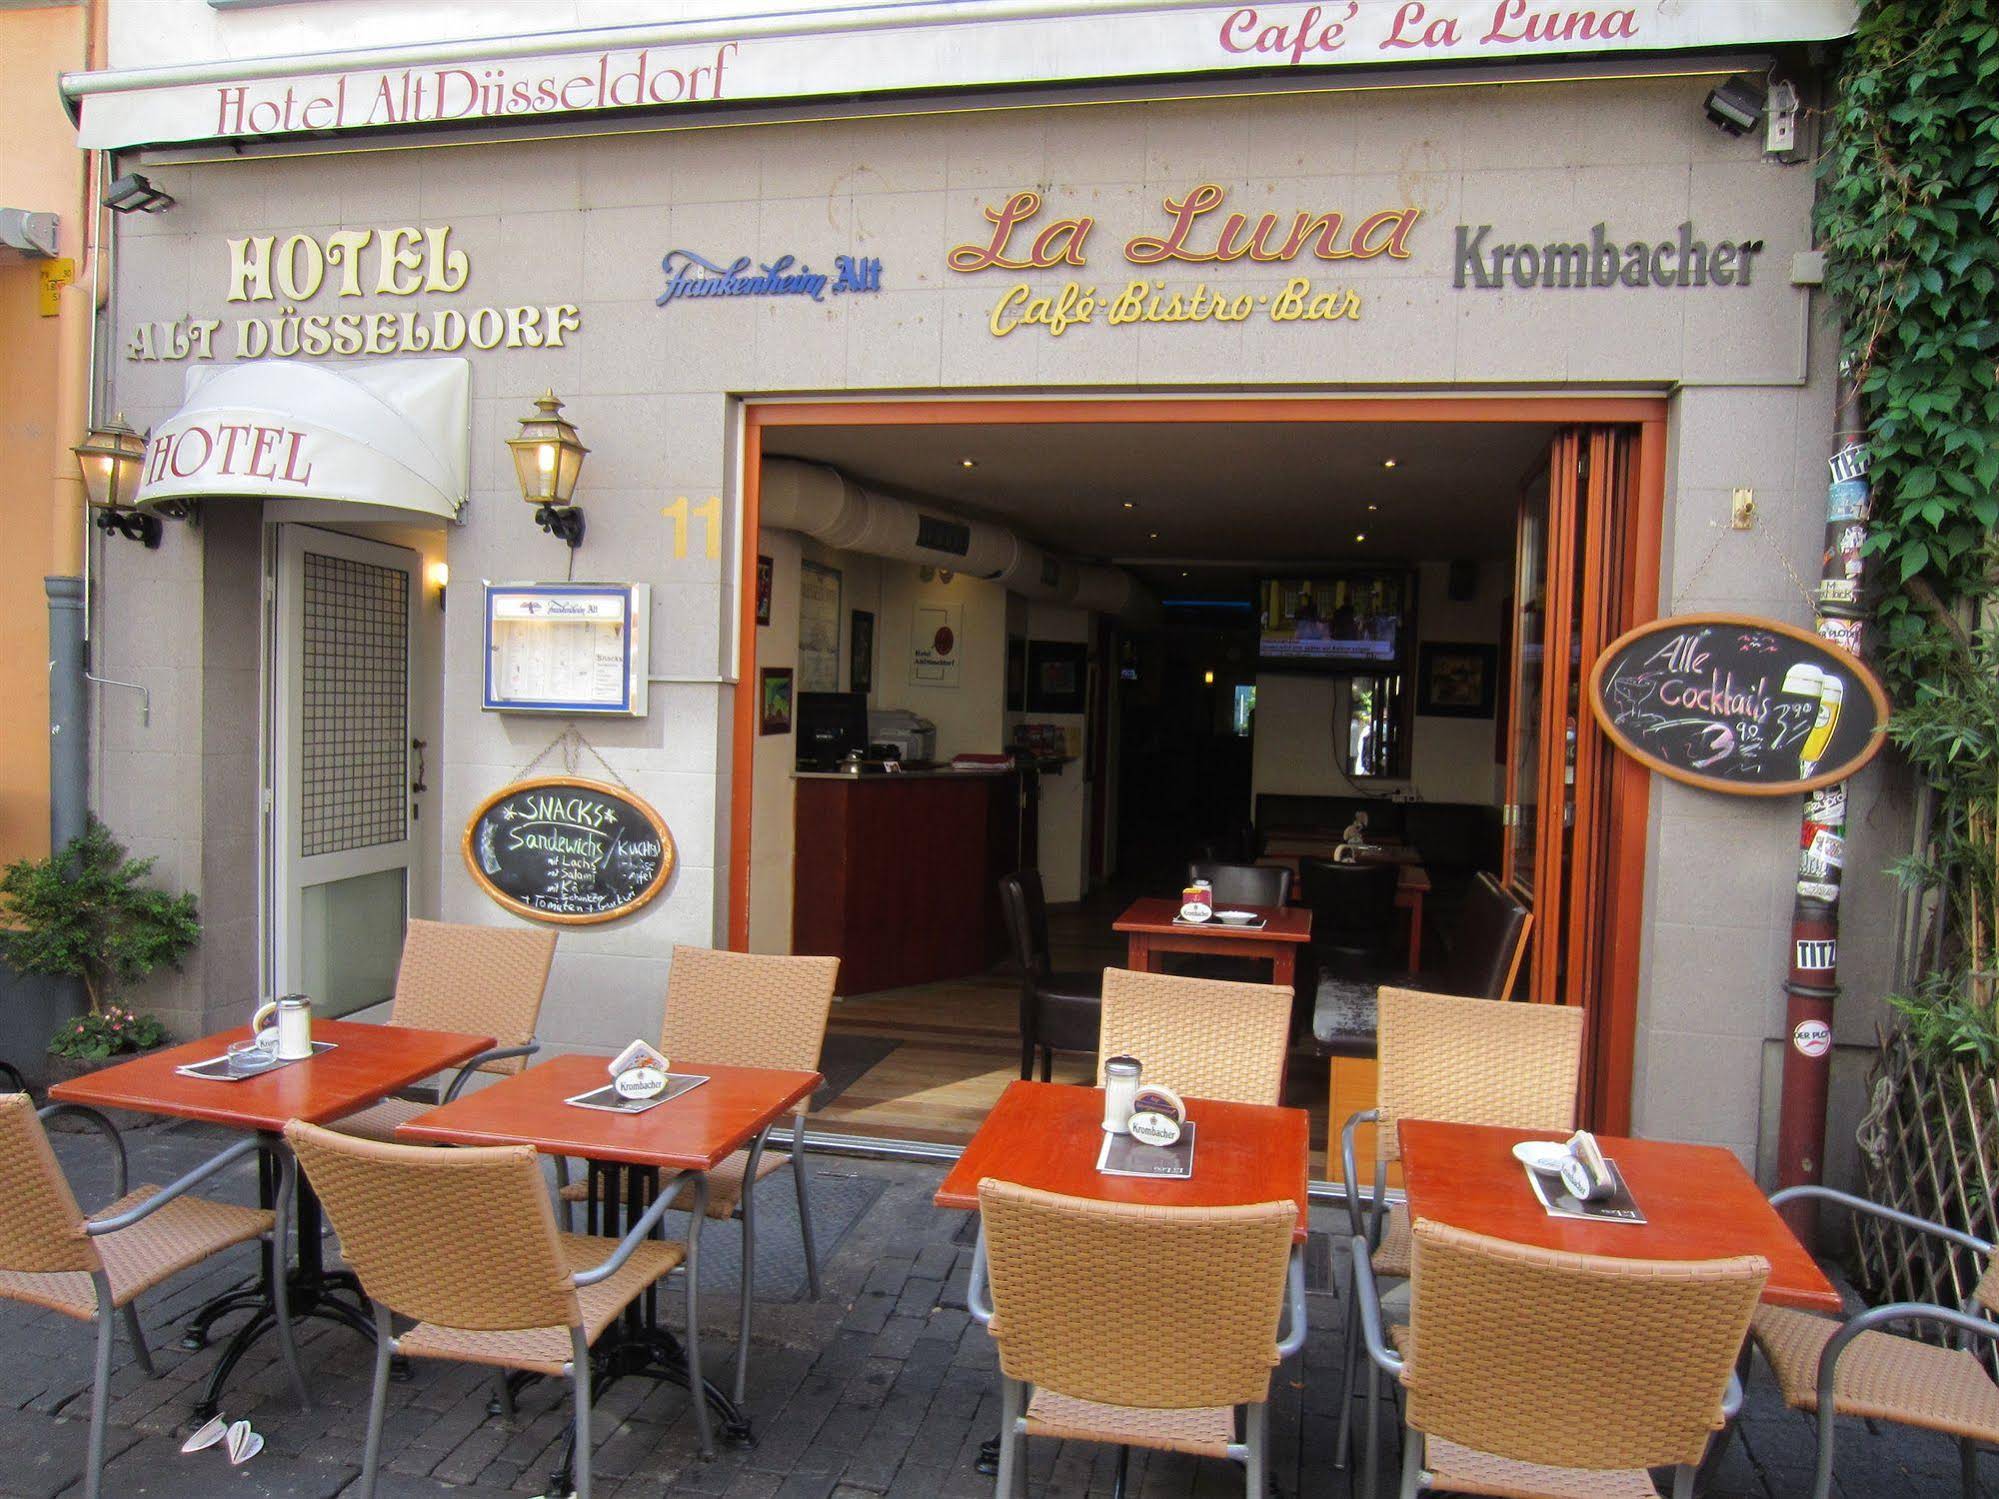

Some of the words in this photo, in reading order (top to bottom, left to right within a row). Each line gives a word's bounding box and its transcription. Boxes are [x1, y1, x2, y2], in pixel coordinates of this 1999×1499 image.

[1379, 1, 1462, 49] La
[1480, 0, 1640, 45] Luna
[213, 72, 346, 136] Hotel
[946, 191, 1095, 272] La
[1124, 184, 1420, 263] Luna
[1452, 220, 1763, 288] Krombacher
[227, 225, 469, 303] HOTEL
[656, 250, 827, 307] Frankenheim
[832, 254, 882, 295] Alt
[127, 316, 221, 361] ALT
[236, 305, 581, 359] DÜSSELDORF
[145, 422, 312, 487] HOTEL
[659, 496, 721, 560] 11
[1644, 635, 1711, 674] Alle
[1660, 667, 1769, 724] Cocktails
[518, 796, 604, 827] SNACKS
[561, 868, 597, 883] Salami
[562, 856, 598, 870] Lachs
[1798, 941, 1835, 968] TITZ
[620, 1082, 662, 1092] Krombacher
[1132, 1122, 1176, 1139] Krombacher
